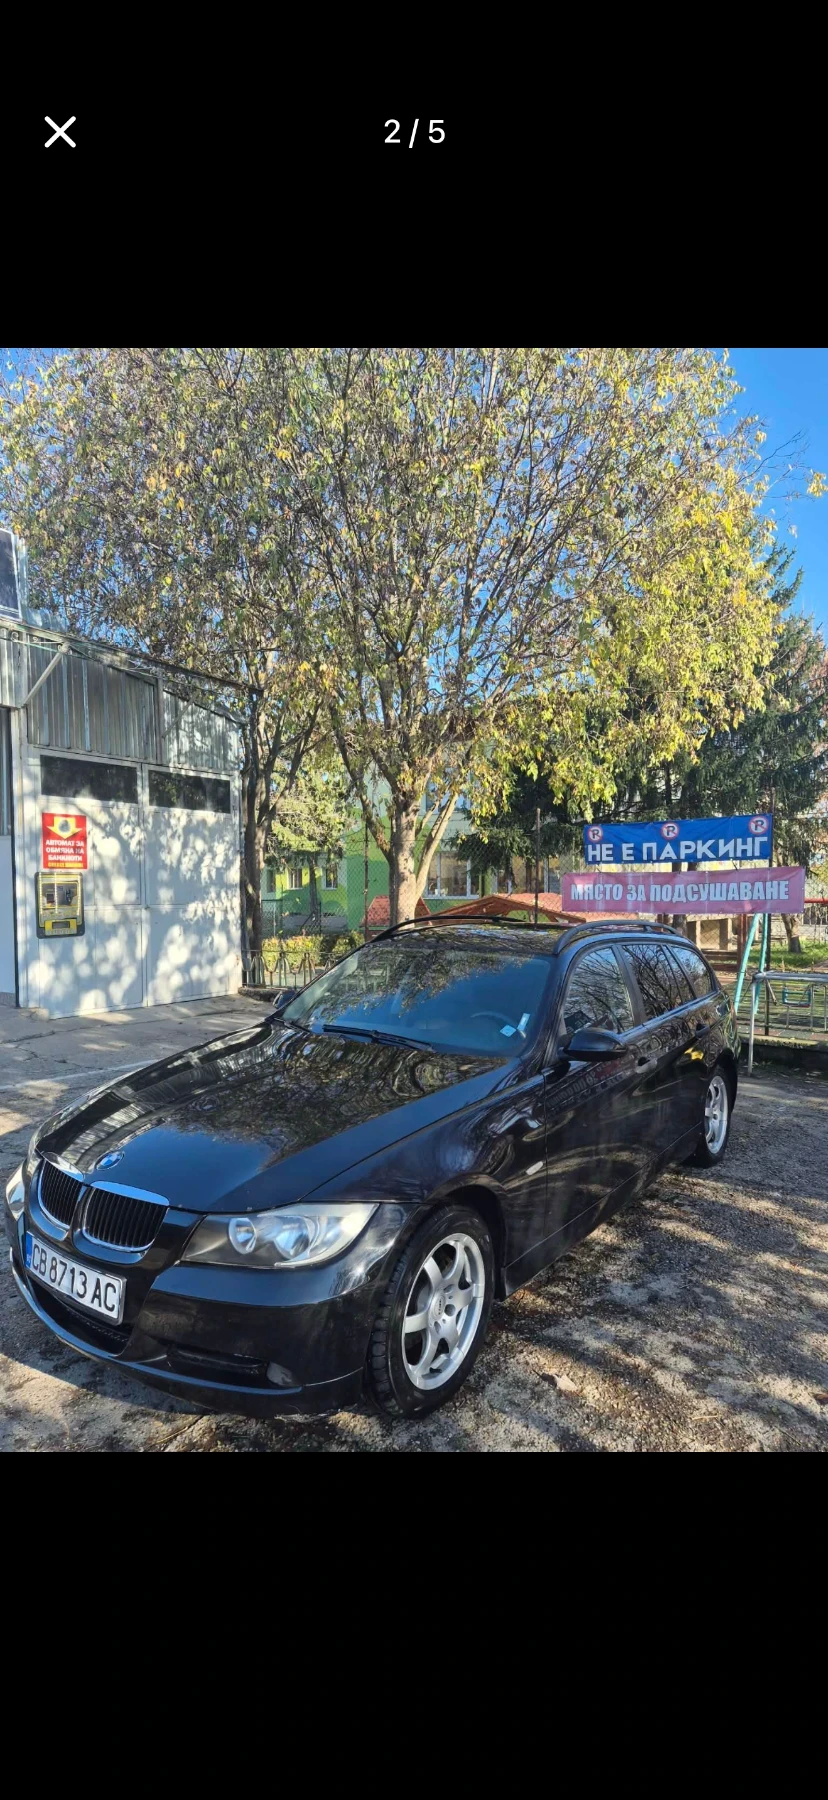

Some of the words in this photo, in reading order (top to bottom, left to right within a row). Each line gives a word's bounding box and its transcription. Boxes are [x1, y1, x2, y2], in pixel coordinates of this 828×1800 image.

[588, 843, 614, 862] НЕ
[622, 843, 635, 861] Е
[642, 836, 768, 860] ПАРКИНГ
[570, 883, 623, 901] МЯСТО
[626, 884, 647, 901] ЗА
[649, 880, 789, 903] ПОДСУШАВАНЕ
[32, 1243, 47, 1277] CB
[49, 1256, 88, 1299] 8713
[91, 1277, 117, 1312] AC
